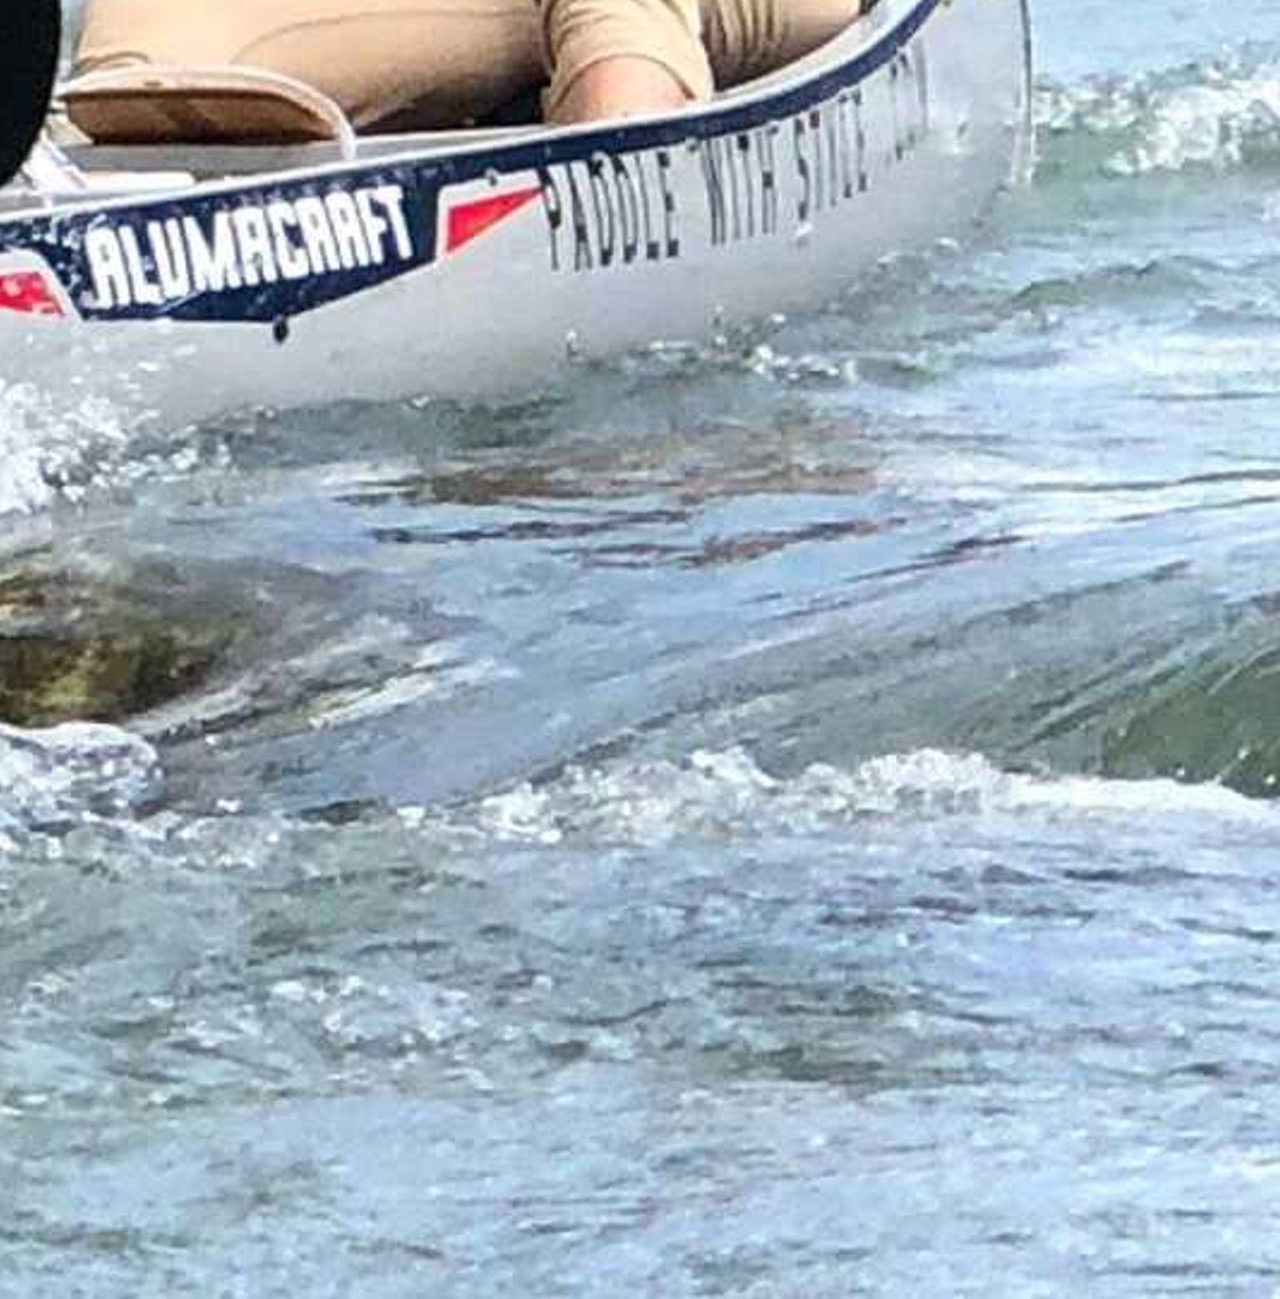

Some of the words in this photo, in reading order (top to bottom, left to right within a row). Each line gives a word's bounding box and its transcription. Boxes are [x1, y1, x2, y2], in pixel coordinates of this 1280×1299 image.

[80, 185, 415, 309] ALUMACRAFT
[538, 149, 680, 273] PADDLE
[703, 126, 780, 247] WITH
